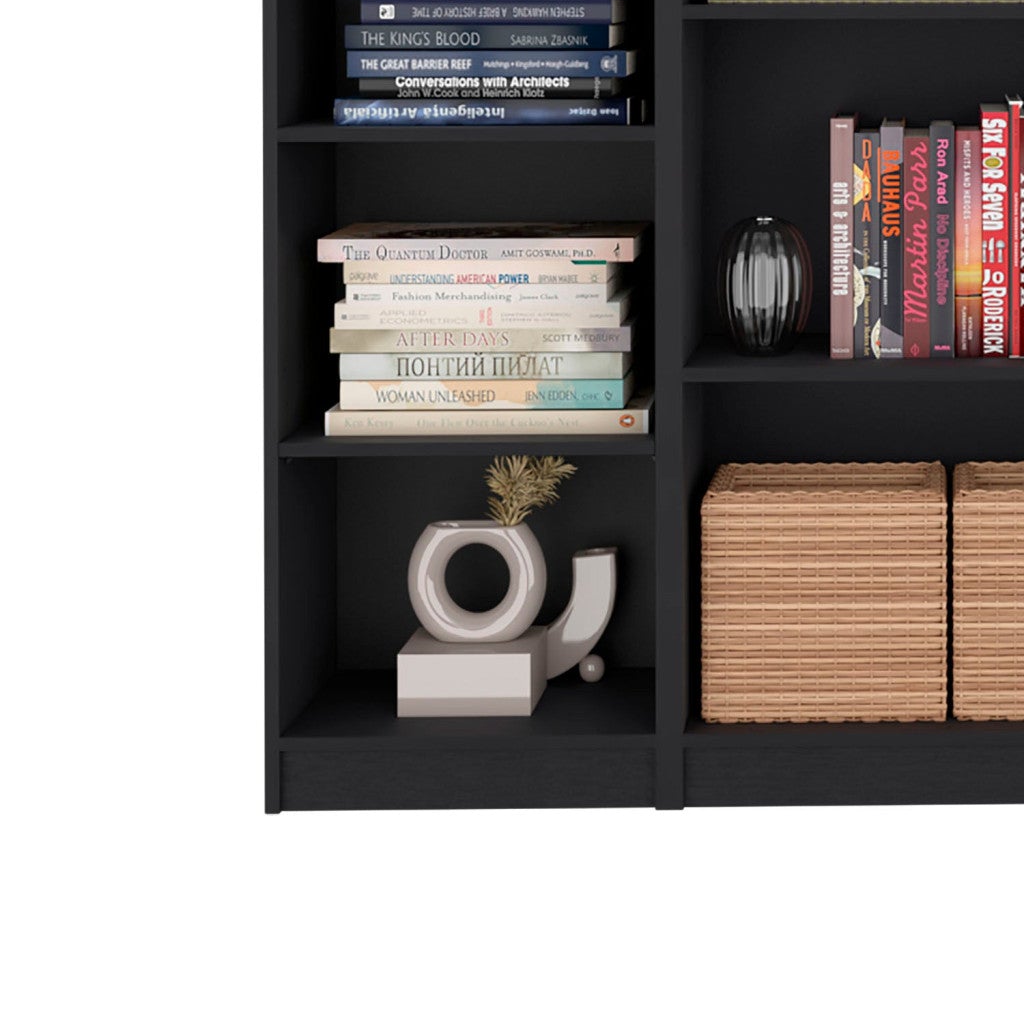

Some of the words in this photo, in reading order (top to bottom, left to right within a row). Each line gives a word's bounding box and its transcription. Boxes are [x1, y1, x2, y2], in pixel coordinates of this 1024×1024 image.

[412, 7, 429, 17] TIME
[432, 7, 442, 17] OF
[443, 7, 476, 17] HISTORY
[479, 7, 500, 17] BRIEF
[501, 7, 507, 17] A
[512, 7, 548, 17] HAWKING
[551, 7, 584, 17] STEPHEN
[361, 30, 384, 46] THE
[390, 30, 430, 46] KING'S
[436, 30, 480, 46] BLOOD
[510, 35, 548, 46] SABRINA
[551, 35, 588, 46] ZBASNIK
[361, 59, 378, 70] THE
[381, 59, 409, 70] GREAT
[411, 59, 450, 70] BARRIER
[454, 59, 472, 70] REEF
[396, 77, 479, 88] Conversations
[483, 77, 506, 88] with
[510, 77, 569, 88] Architects
[937, 139, 947, 167] Ron
[963, 140, 971, 169] MISFITS
[963, 171, 971, 188] AND
[882, 150, 900, 237] BAUHAUS
[937, 171, 947, 204] Arad
[963, 190, 971, 219] HEROES
[936, 214, 947, 233] No
[343, 246, 370, 260] THE
[376, 246, 434, 260] QUANTUM
[439, 246, 488, 260] DOCTOR
[935, 238, 948, 304] Discipline
[390, 274, 454, 284] UNDERSTANDING
[456, 274, 496, 284] AMERICAN
[499, 274, 529, 284] POWER
[393, 292, 431, 301] Fashion
[435, 292, 512, 302] Merchandising
[983, 287, 1006, 353] RODERICK
[397, 332, 453, 346] AFTER
[463, 332, 509, 346] DAYS
[542, 334, 570, 342] SCOTT
[574, 334, 619, 342] MEDBURY
[397, 353, 485, 376] ПОНТИЙ
[492, 356, 563, 376] ПИЛАТ
[376, 390, 424, 403] WOMAN
[428, 390, 495, 403] UNLEASHED
